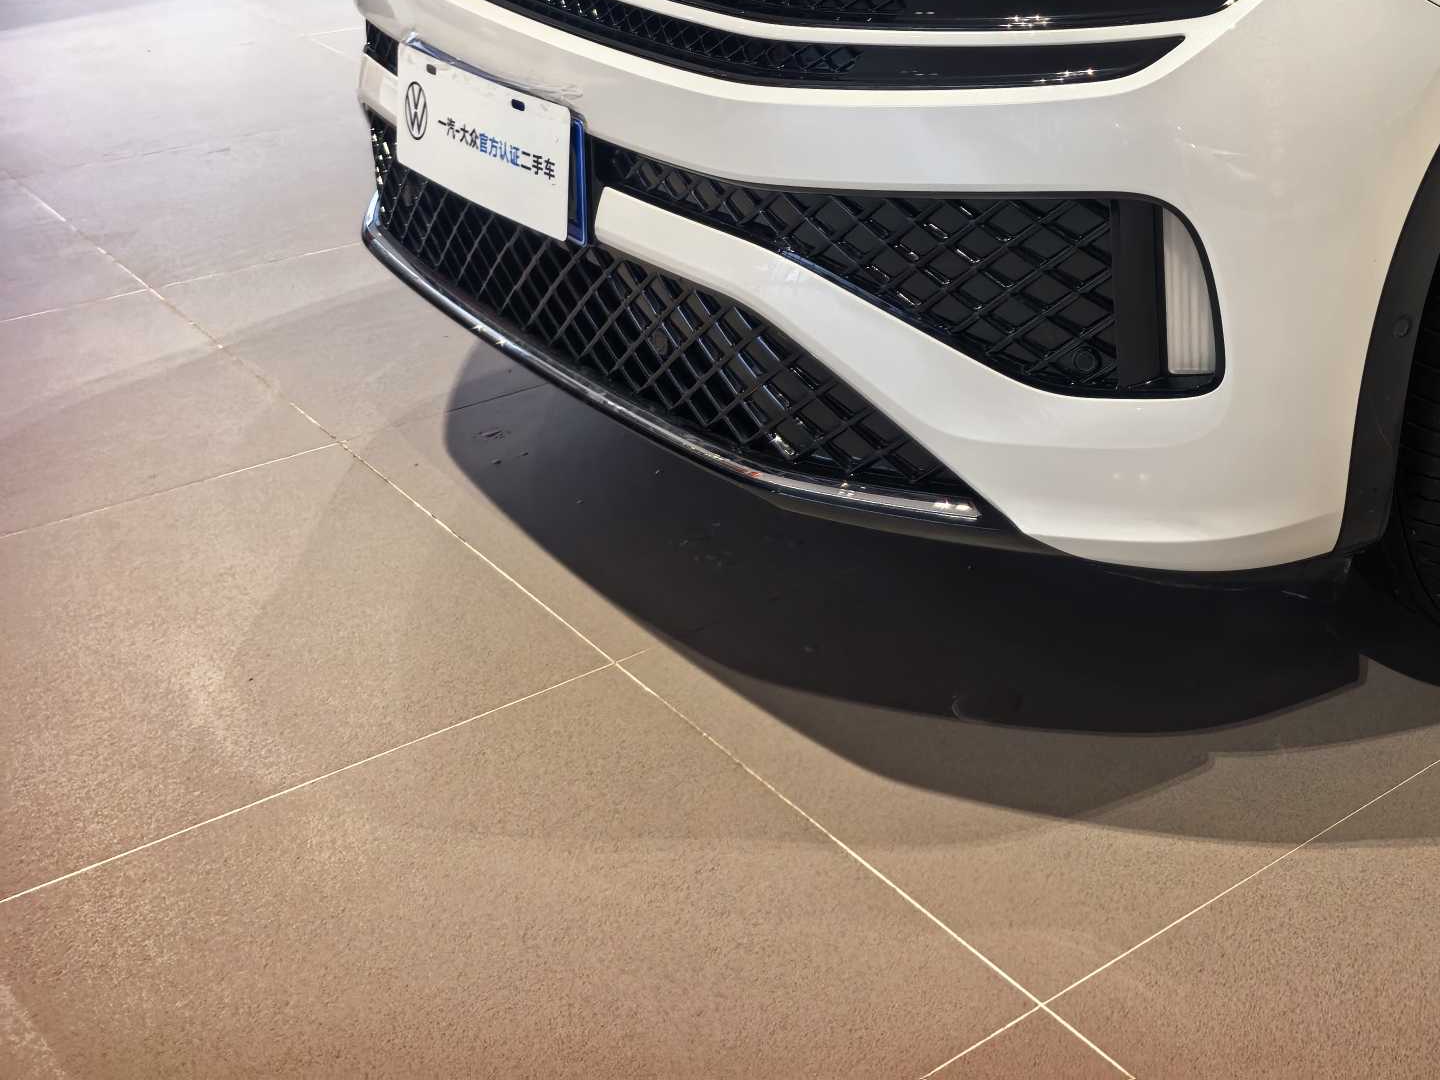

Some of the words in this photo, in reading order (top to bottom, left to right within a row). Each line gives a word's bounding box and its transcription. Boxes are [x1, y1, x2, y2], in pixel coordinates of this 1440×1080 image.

[404, 80, 429, 141] VW
[437, 117, 556, 181] 一汽-大众官方认证二手车
